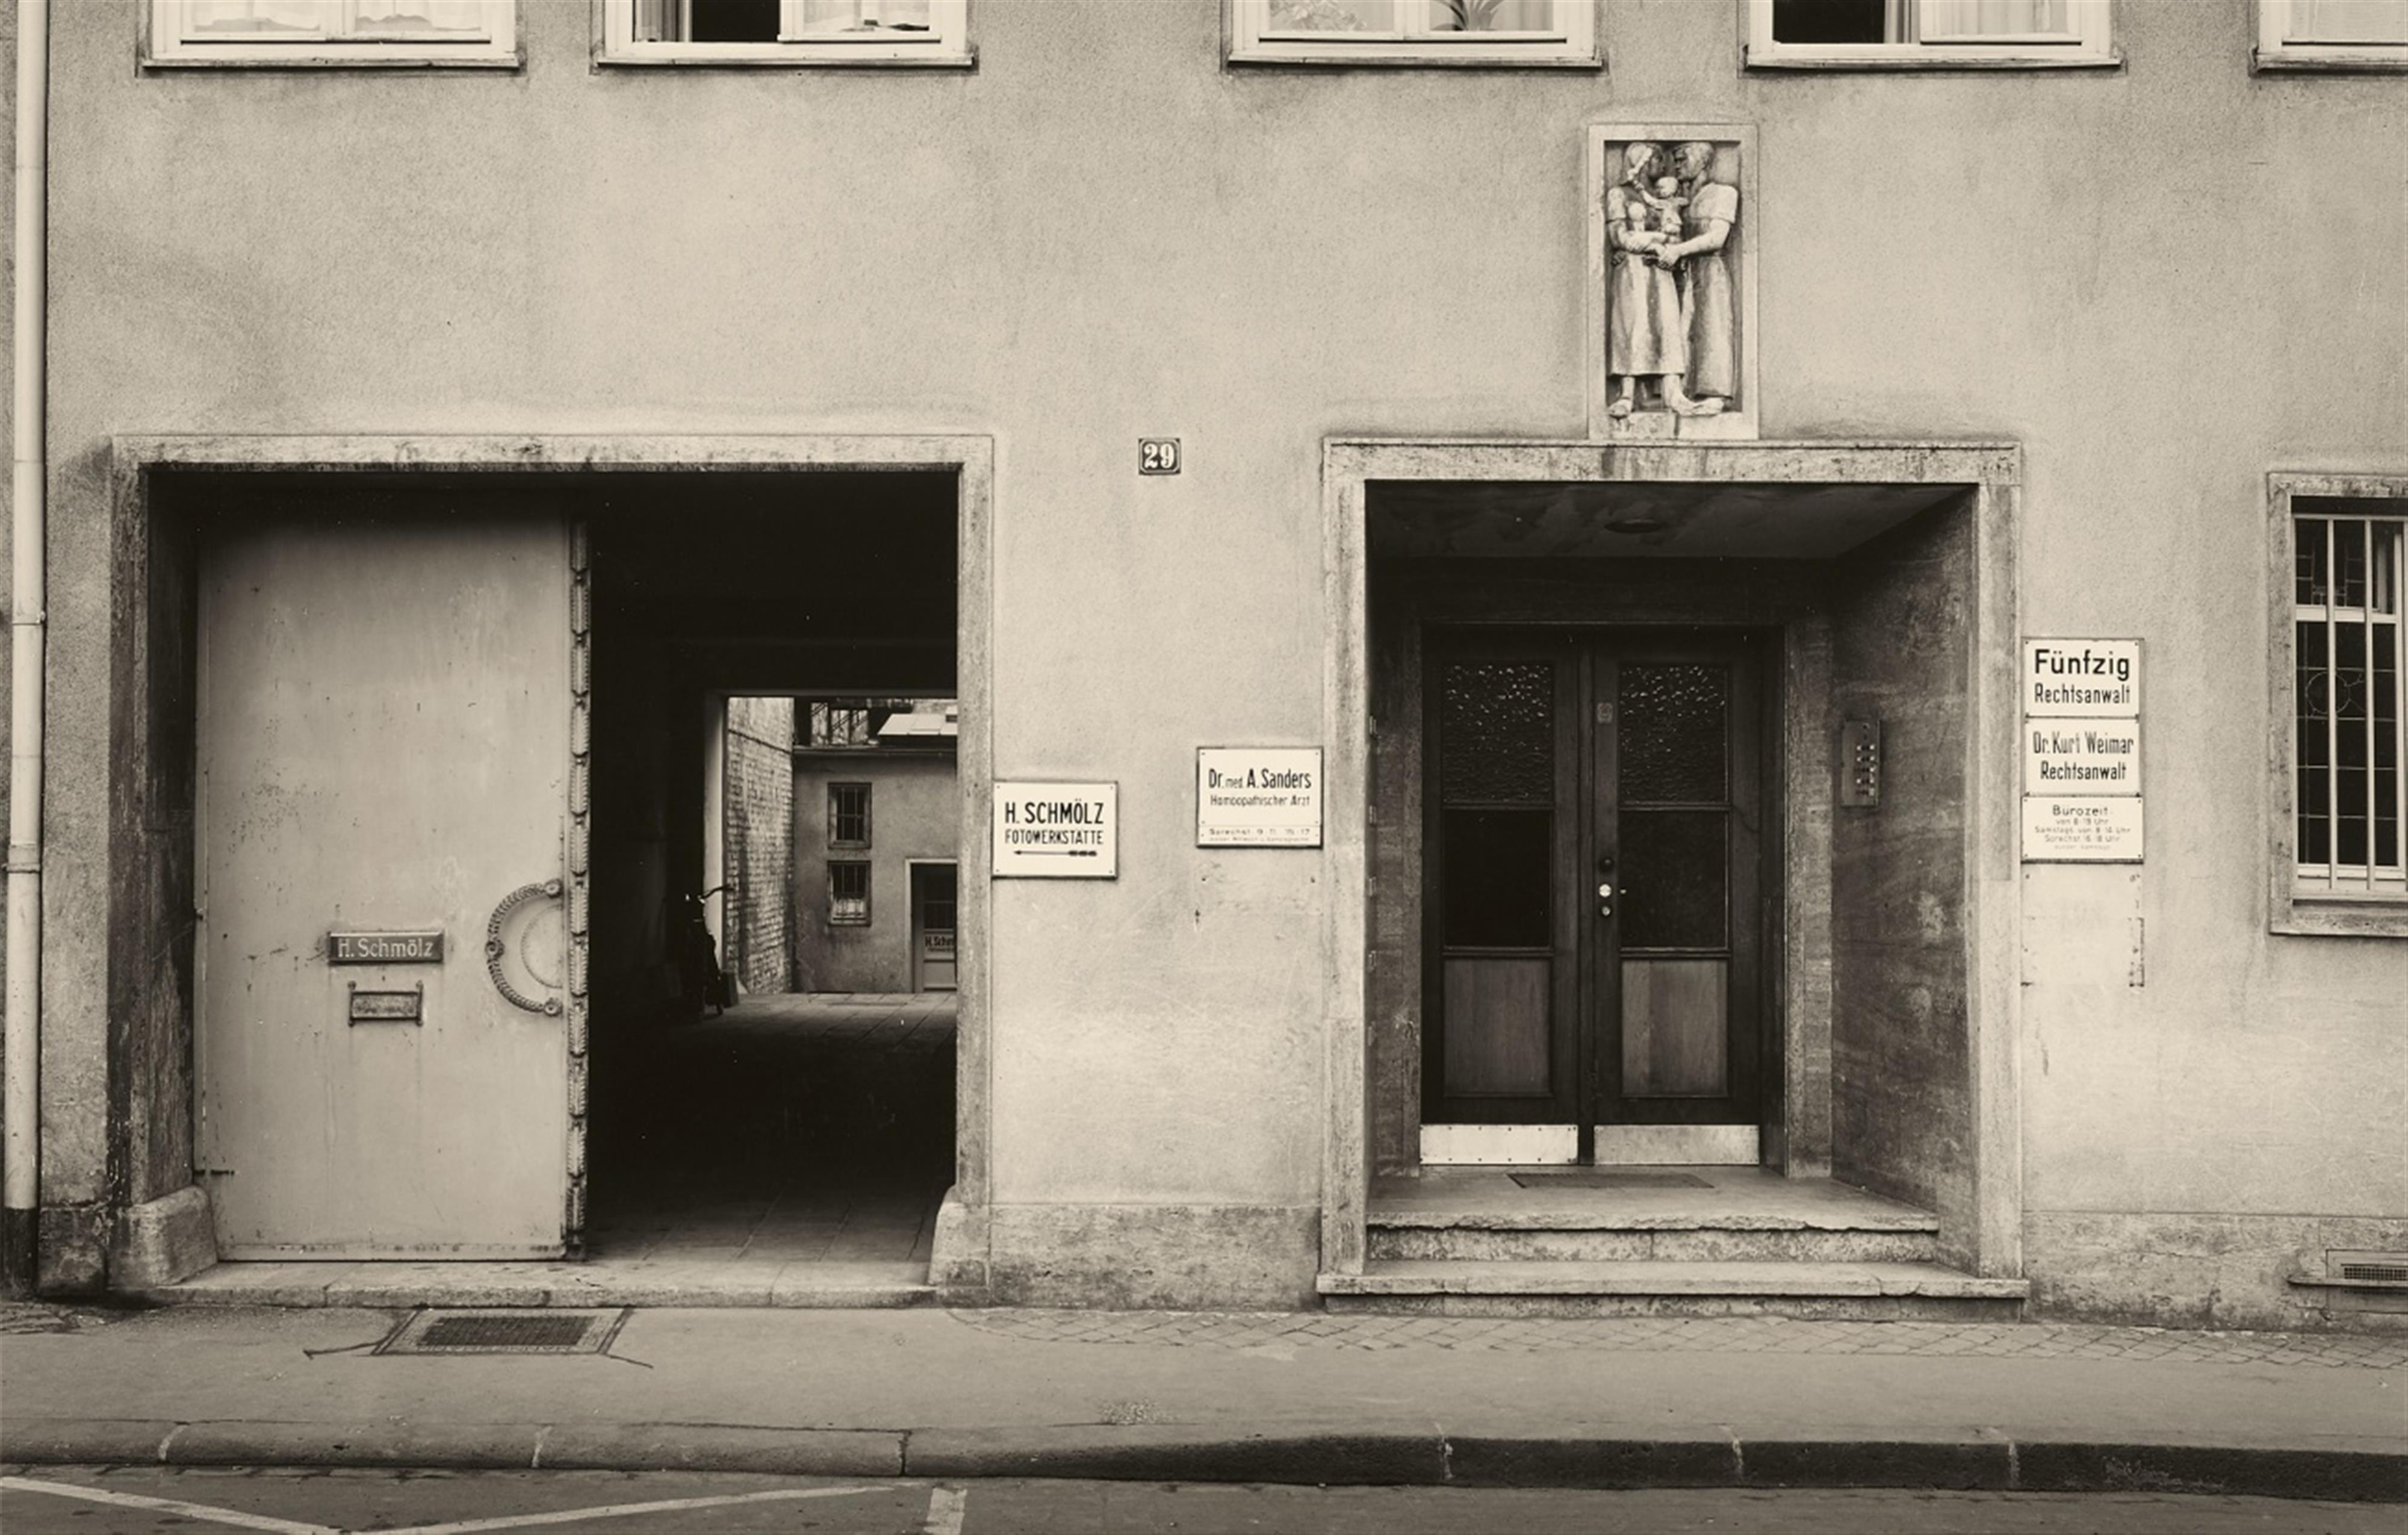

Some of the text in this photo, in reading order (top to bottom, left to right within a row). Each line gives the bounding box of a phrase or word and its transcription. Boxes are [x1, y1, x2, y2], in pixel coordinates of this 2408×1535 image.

[1144, 444, 1175, 468] 29
[2035, 649, 2129, 681] Fünfzig
[2035, 683, 2130, 704] Rechtsanwalt
[2052, 731, 2081, 754] Kurt
[2085, 731, 2134, 754] Weimar
[1261, 768, 1311, 789] Sanders
[2040, 760, 2126, 780] Rechtsanwalt
[1005, 798, 1103, 824] H. SCHMÖLZ
[1290, 795, 1310, 806] Arzt
[338, 938, 433, 957] H. Schmölz
